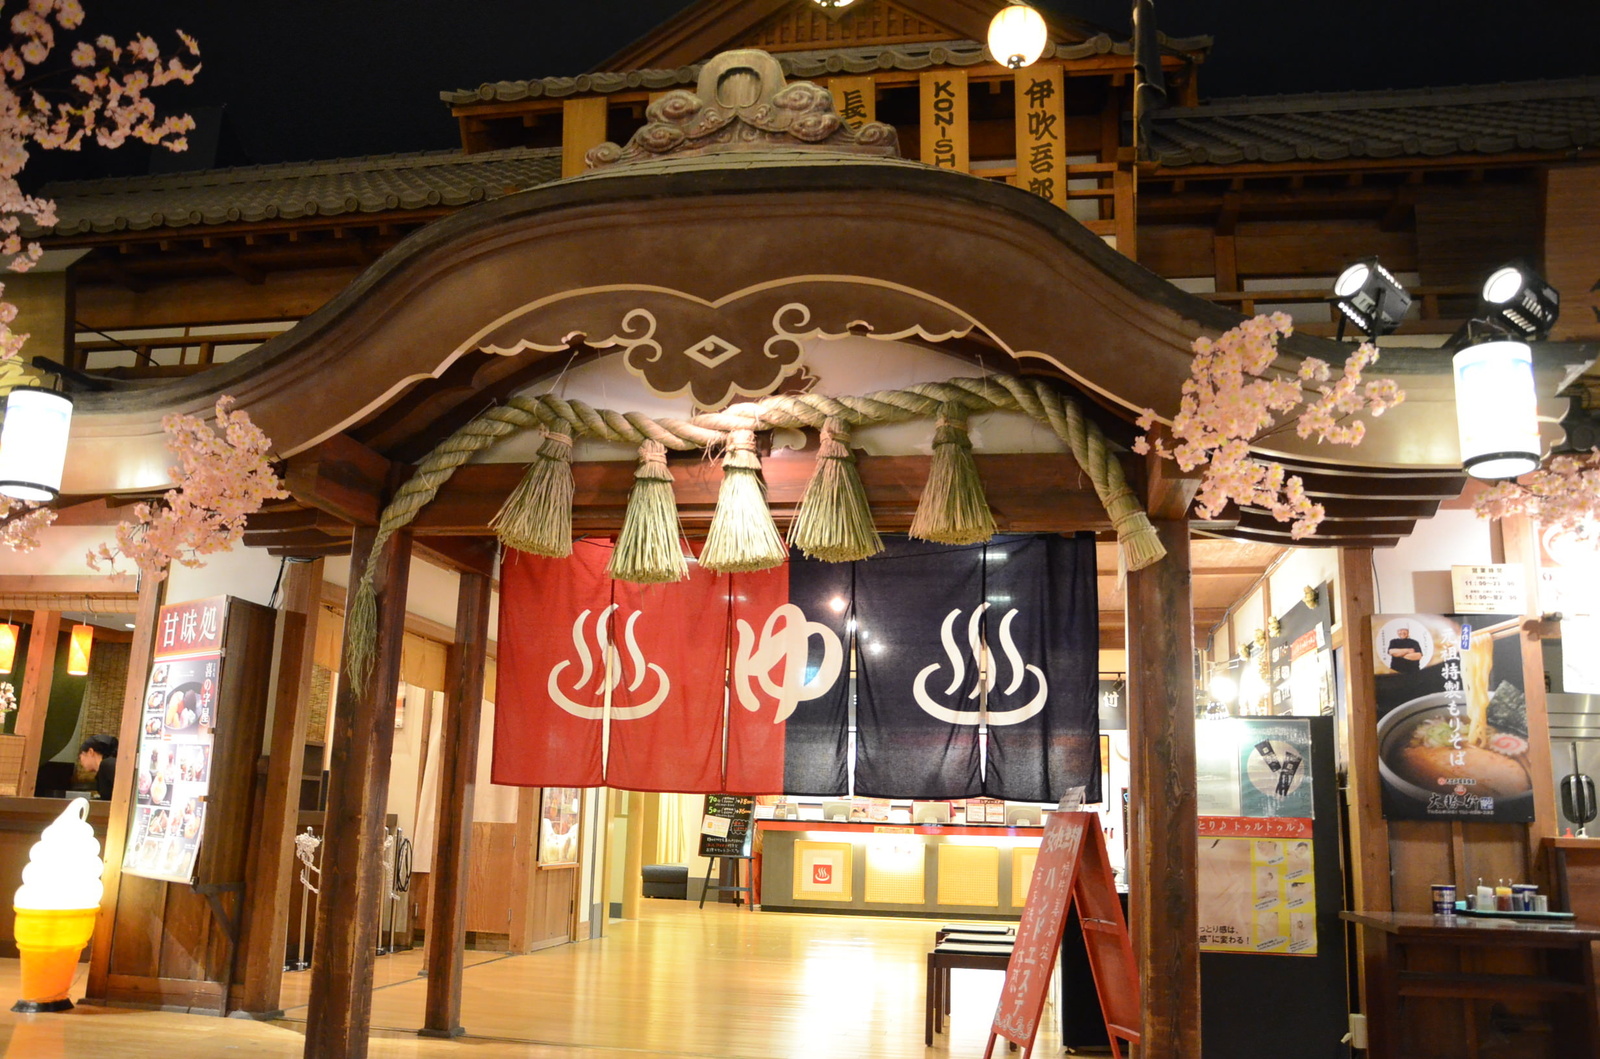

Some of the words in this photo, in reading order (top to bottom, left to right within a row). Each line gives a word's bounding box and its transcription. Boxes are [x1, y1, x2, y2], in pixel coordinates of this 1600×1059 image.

[841, 90, 867, 128] 長
[1024, 78, 1058, 201] 伊吹吾郎
[164, 606, 217, 647] 甘味処
[735, 603, 844, 724] ゆ
[1461, 625, 1470, 648] 手作り
[1440, 627, 1467, 767] 元祖特製もりそば
[1013, 867, 1057, 1016] ハンドエステ
